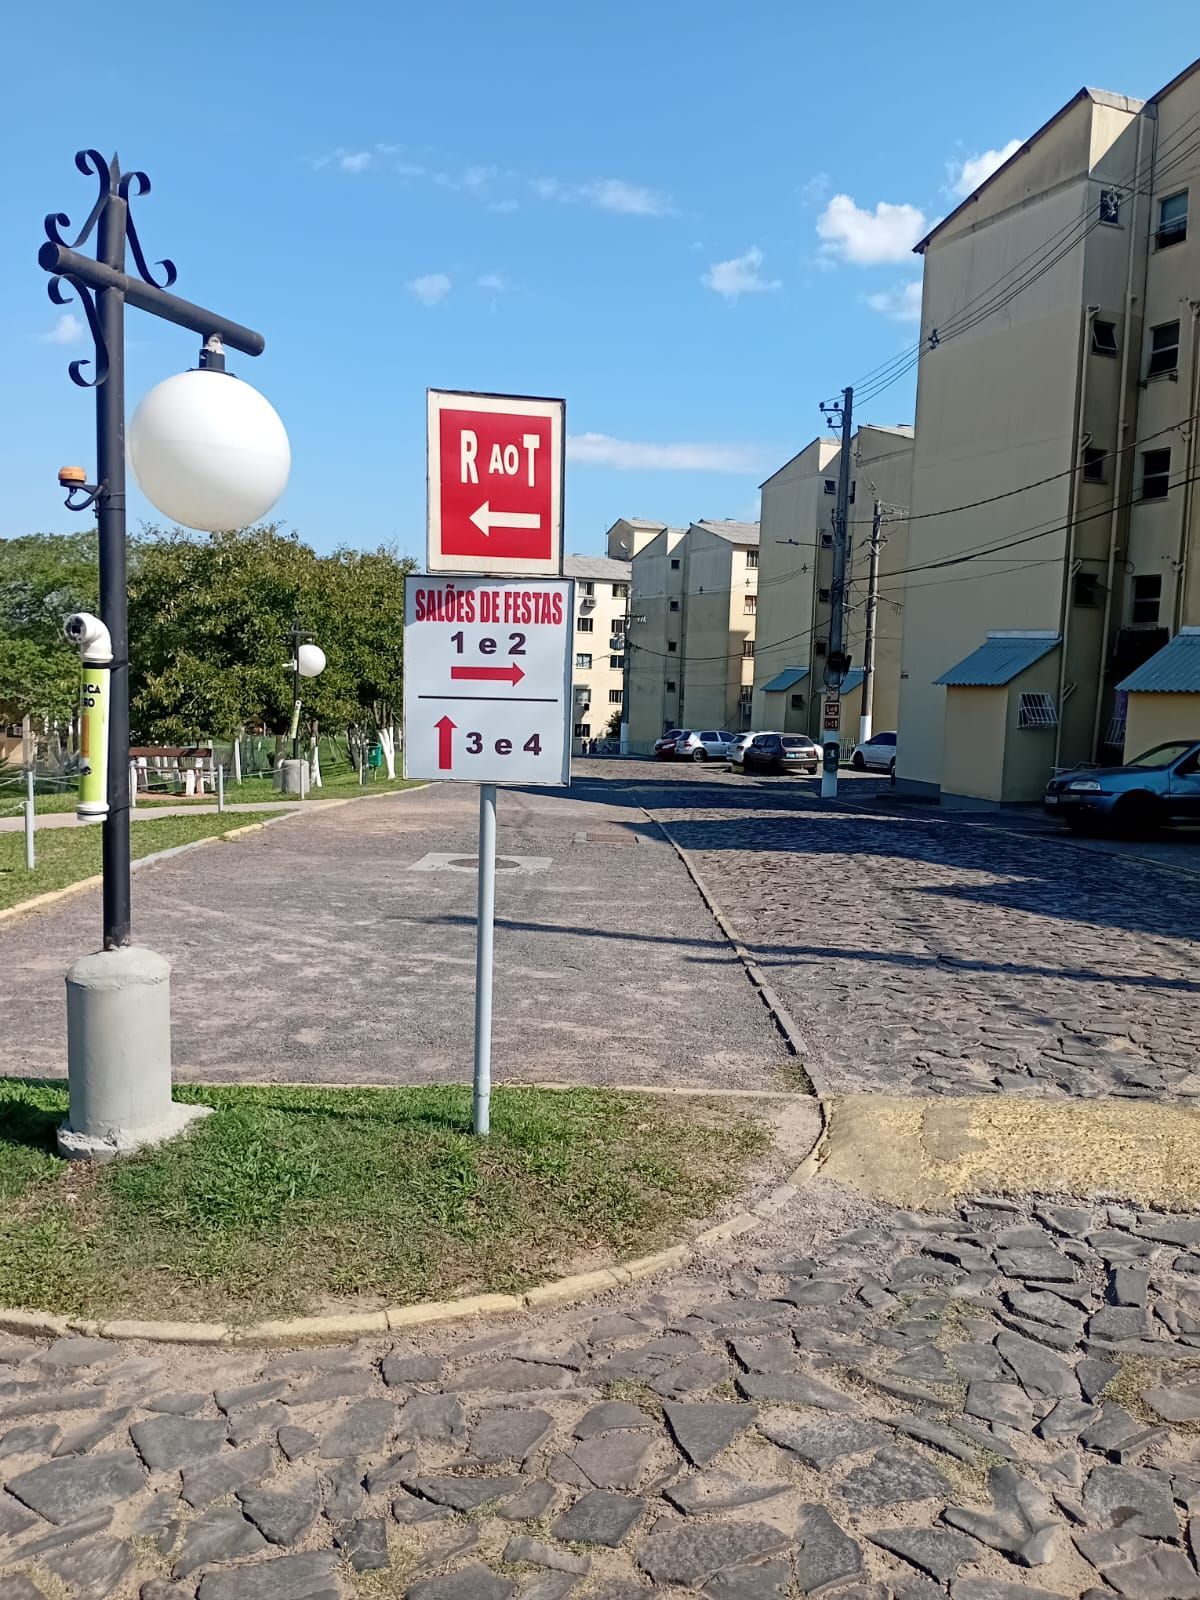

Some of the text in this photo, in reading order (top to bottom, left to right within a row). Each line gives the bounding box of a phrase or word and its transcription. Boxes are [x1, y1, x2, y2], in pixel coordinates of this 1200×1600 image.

[461, 430, 540, 486] R AO T
[415, 584, 563, 625] SALÕES DE FESTAS
[450, 631, 526, 655] 1 e 2
[466, 732, 542, 756] 3 e 4
